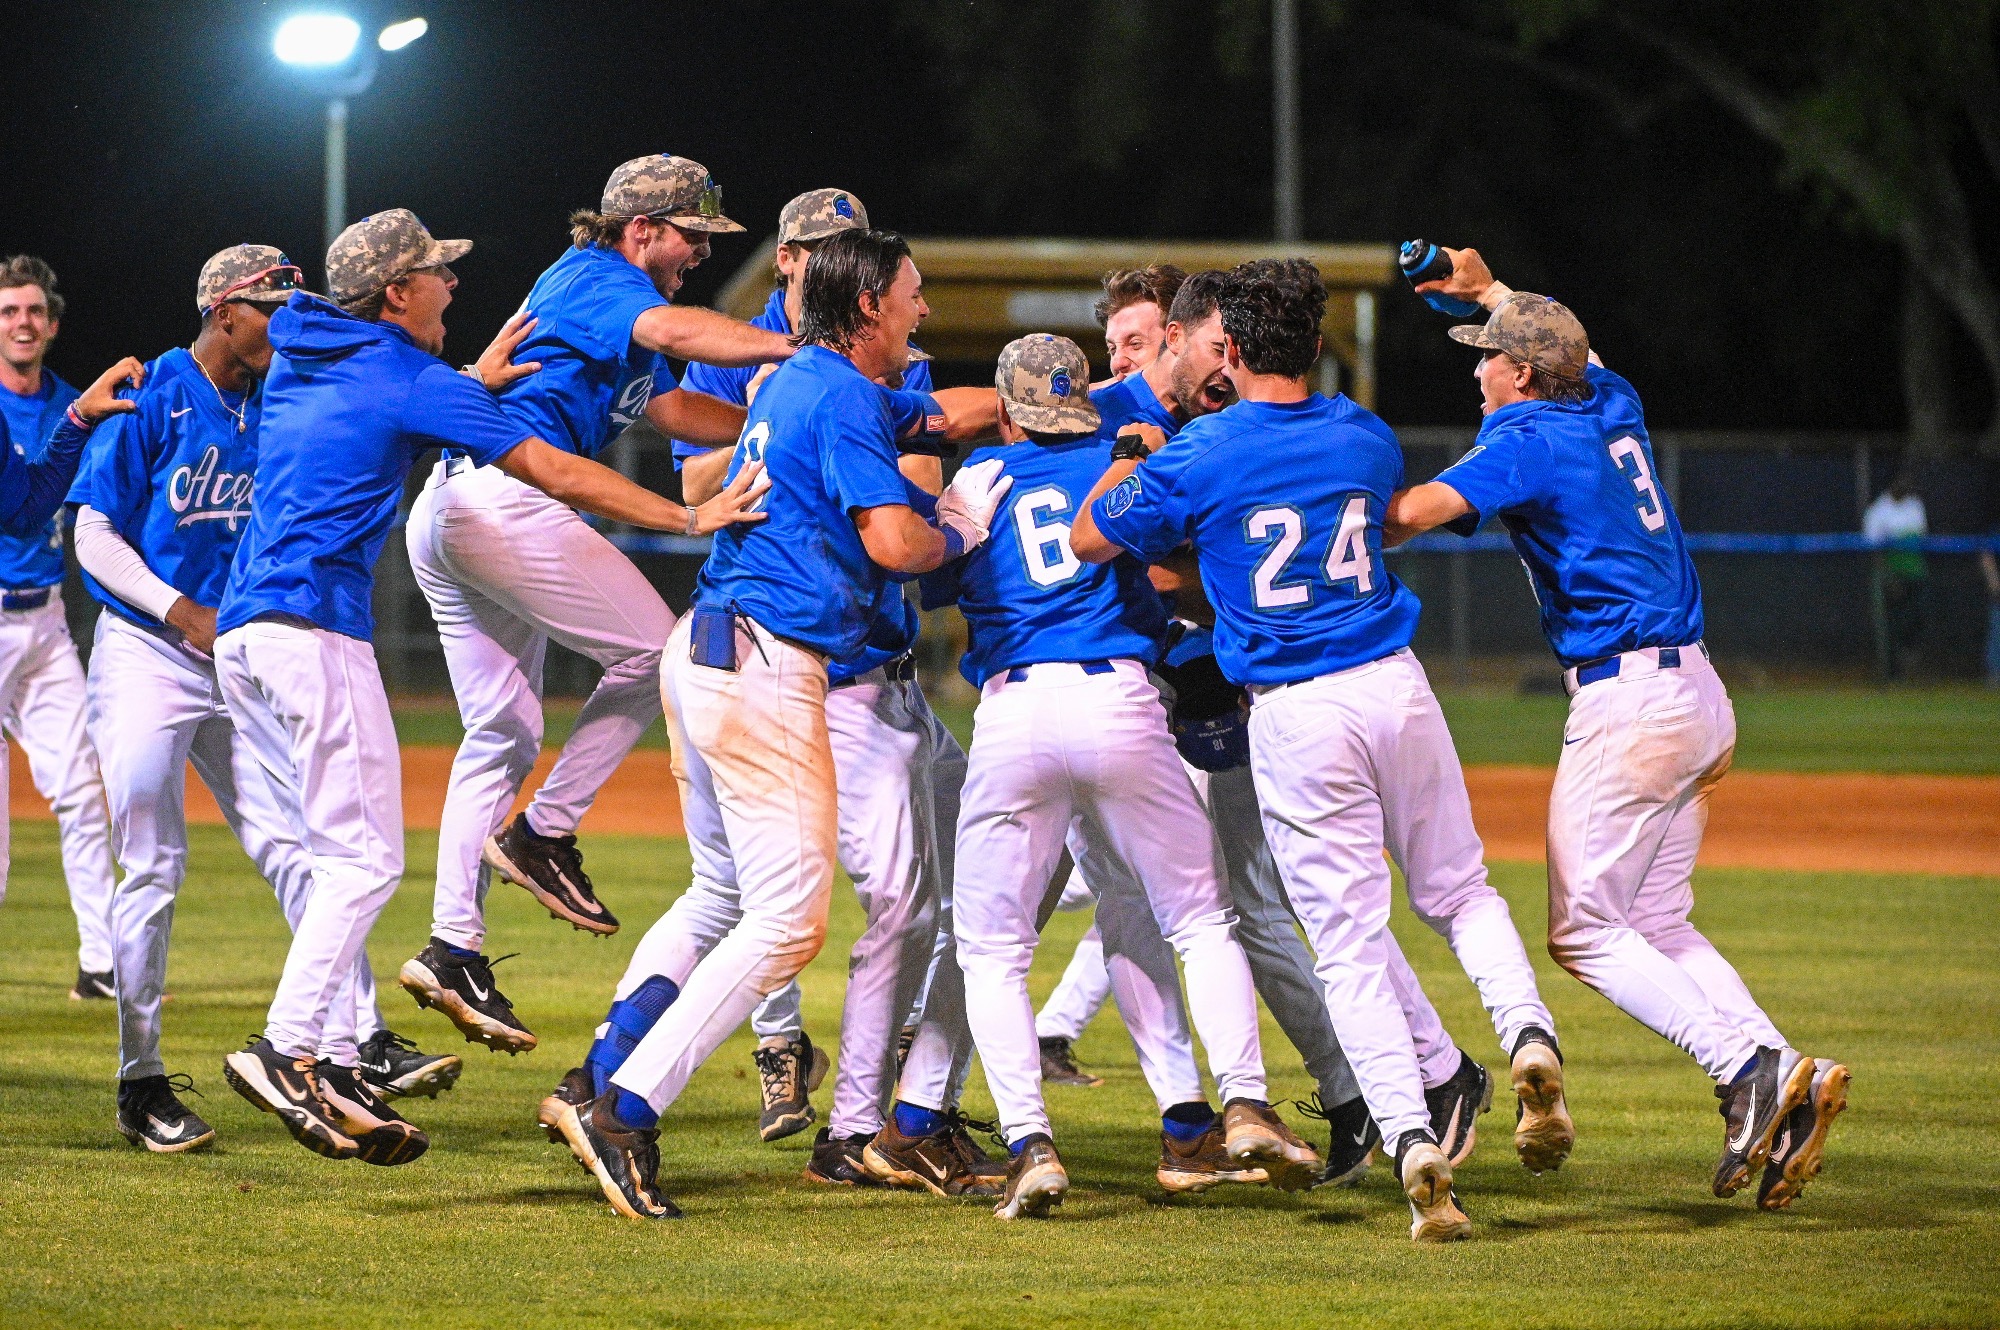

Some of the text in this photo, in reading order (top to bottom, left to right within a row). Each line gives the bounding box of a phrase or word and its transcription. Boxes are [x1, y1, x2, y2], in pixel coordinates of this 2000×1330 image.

[1607, 434, 1666, 533] 3
[1012, 486, 1082, 588] 6
[1246, 495, 1373, 610] 24
